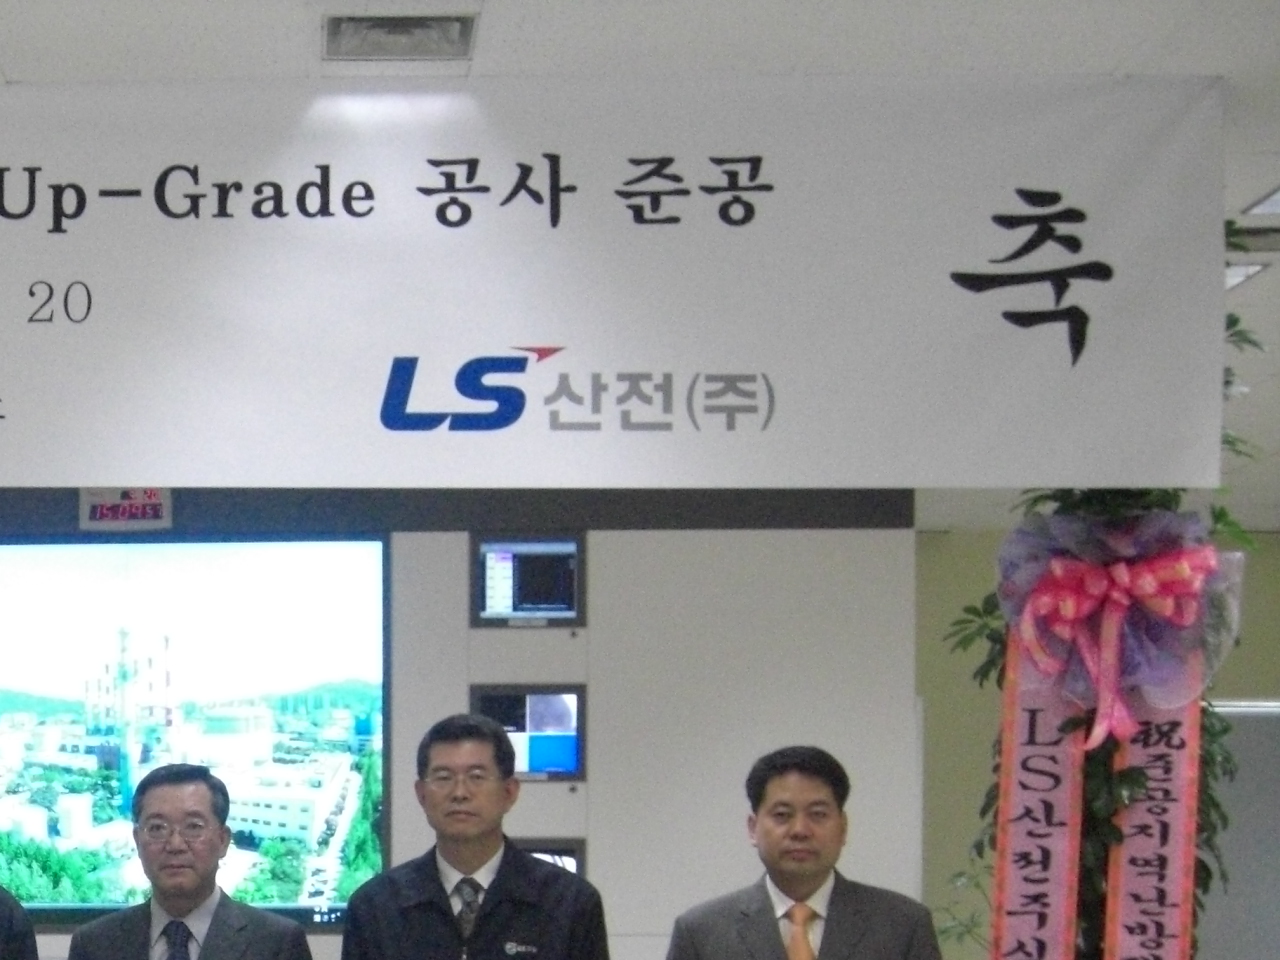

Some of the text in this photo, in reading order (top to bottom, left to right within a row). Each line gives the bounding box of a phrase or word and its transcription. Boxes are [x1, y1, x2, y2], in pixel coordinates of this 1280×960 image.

[416, 152, 578, 229] 공사
[614, 155, 775, 227] 준공
[27, 280, 93, 324] 20
[950, 188, 1114, 367] 축
